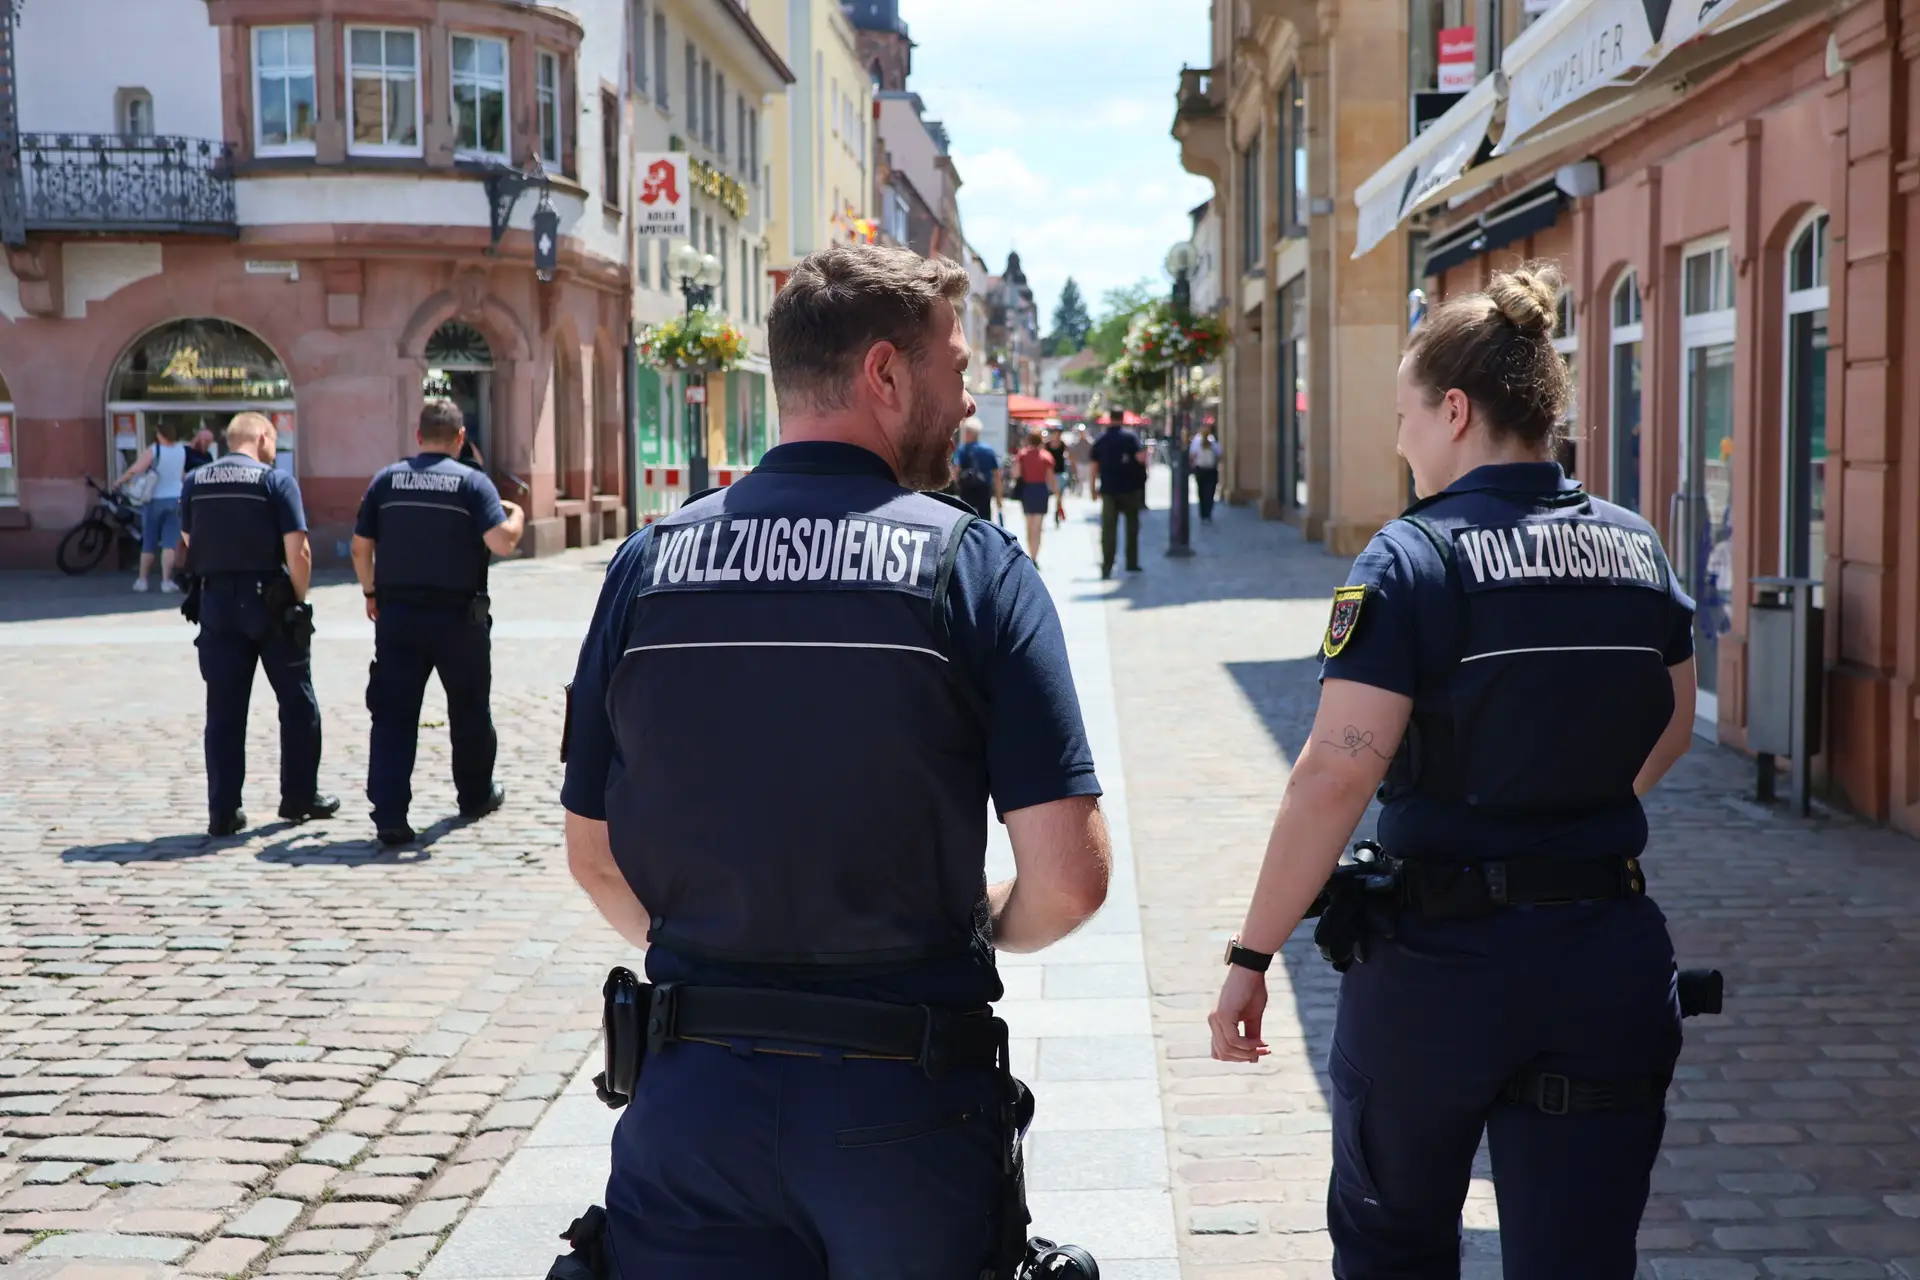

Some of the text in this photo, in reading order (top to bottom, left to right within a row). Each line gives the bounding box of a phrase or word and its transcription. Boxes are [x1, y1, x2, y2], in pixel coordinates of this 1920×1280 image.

[1536, 23, 1623, 112] UWELIER
[638, 224, 685, 235] APOTHEKE
[391, 471, 462, 493] VOLLZUGSDIENST
[652, 517, 931, 586] VOLLZUGSDIENST
[1460, 523, 1661, 584] VOLLZUGSDIENST
